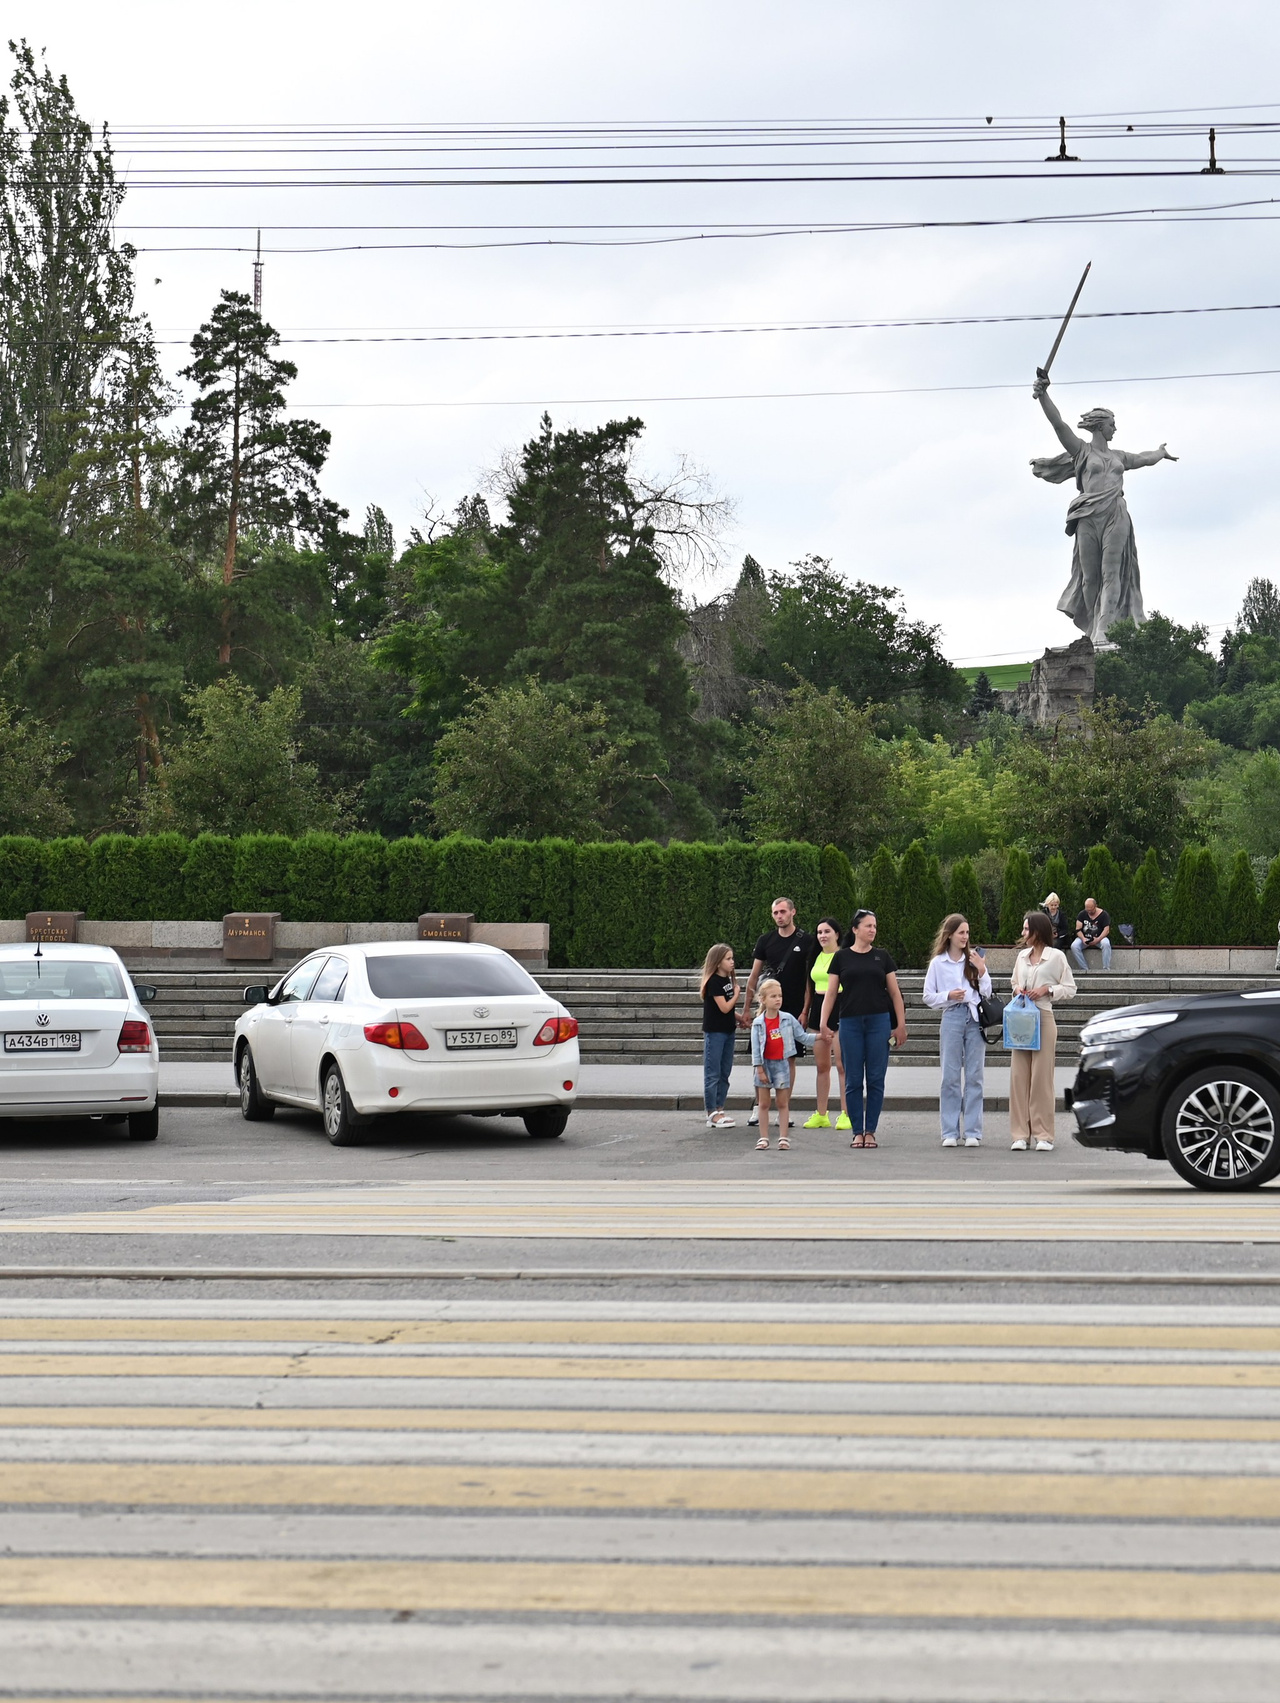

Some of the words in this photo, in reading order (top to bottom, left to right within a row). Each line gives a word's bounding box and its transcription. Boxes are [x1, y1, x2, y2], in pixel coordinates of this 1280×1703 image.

[422, 929, 462, 937] СМОЛЕНСК
[59, 1033, 77, 1043] 198
[501, 1030, 513, 1039] 89
